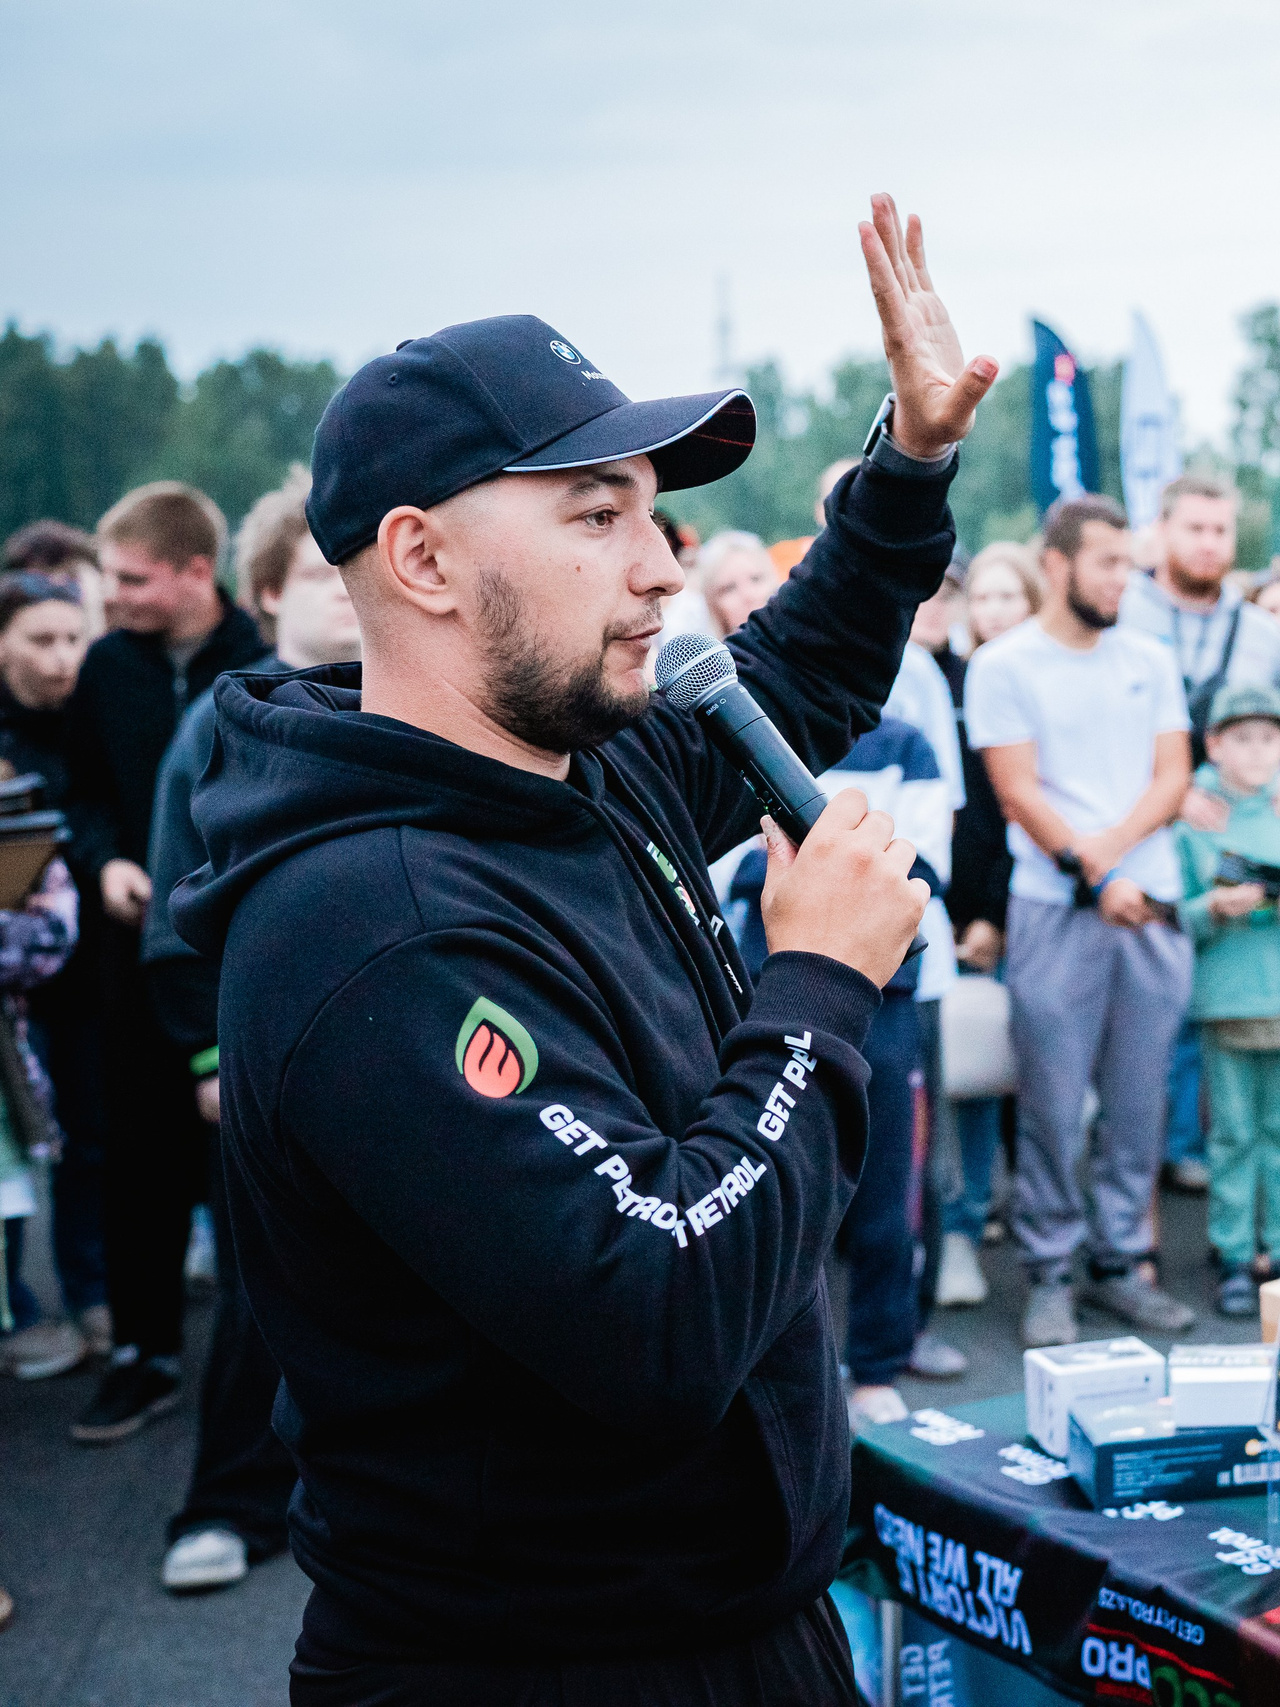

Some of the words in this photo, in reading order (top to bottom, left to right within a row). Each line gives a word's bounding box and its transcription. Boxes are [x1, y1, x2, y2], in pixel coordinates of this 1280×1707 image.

[540, 1103, 607, 1156] GET
[757, 1081, 796, 1141] GET
[1081, 1636, 1152, 1691] PRO
